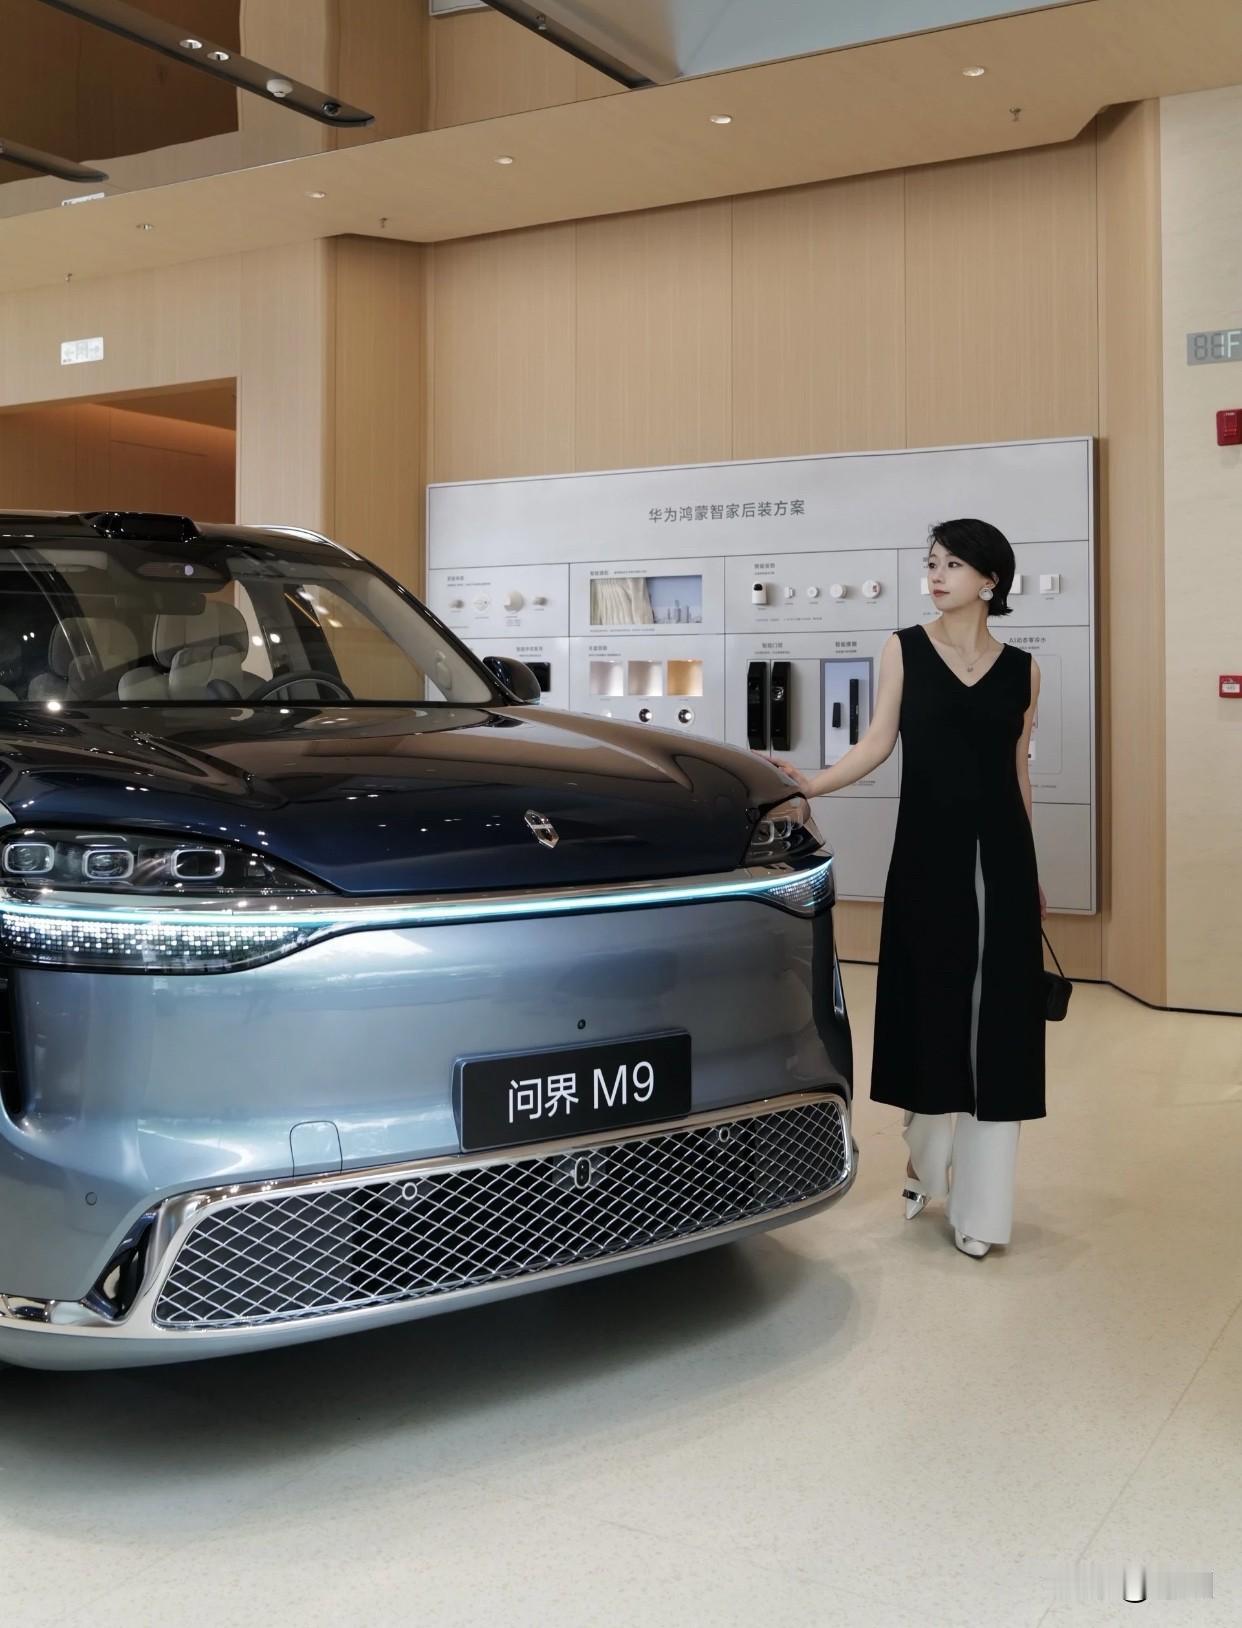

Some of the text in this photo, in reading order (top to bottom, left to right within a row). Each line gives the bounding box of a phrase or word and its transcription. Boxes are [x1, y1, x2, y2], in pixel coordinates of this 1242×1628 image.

[648, 499, 806, 524] 华为鸿蒙智家后装方案
[508, 1061, 655, 1124] 问界 M9
